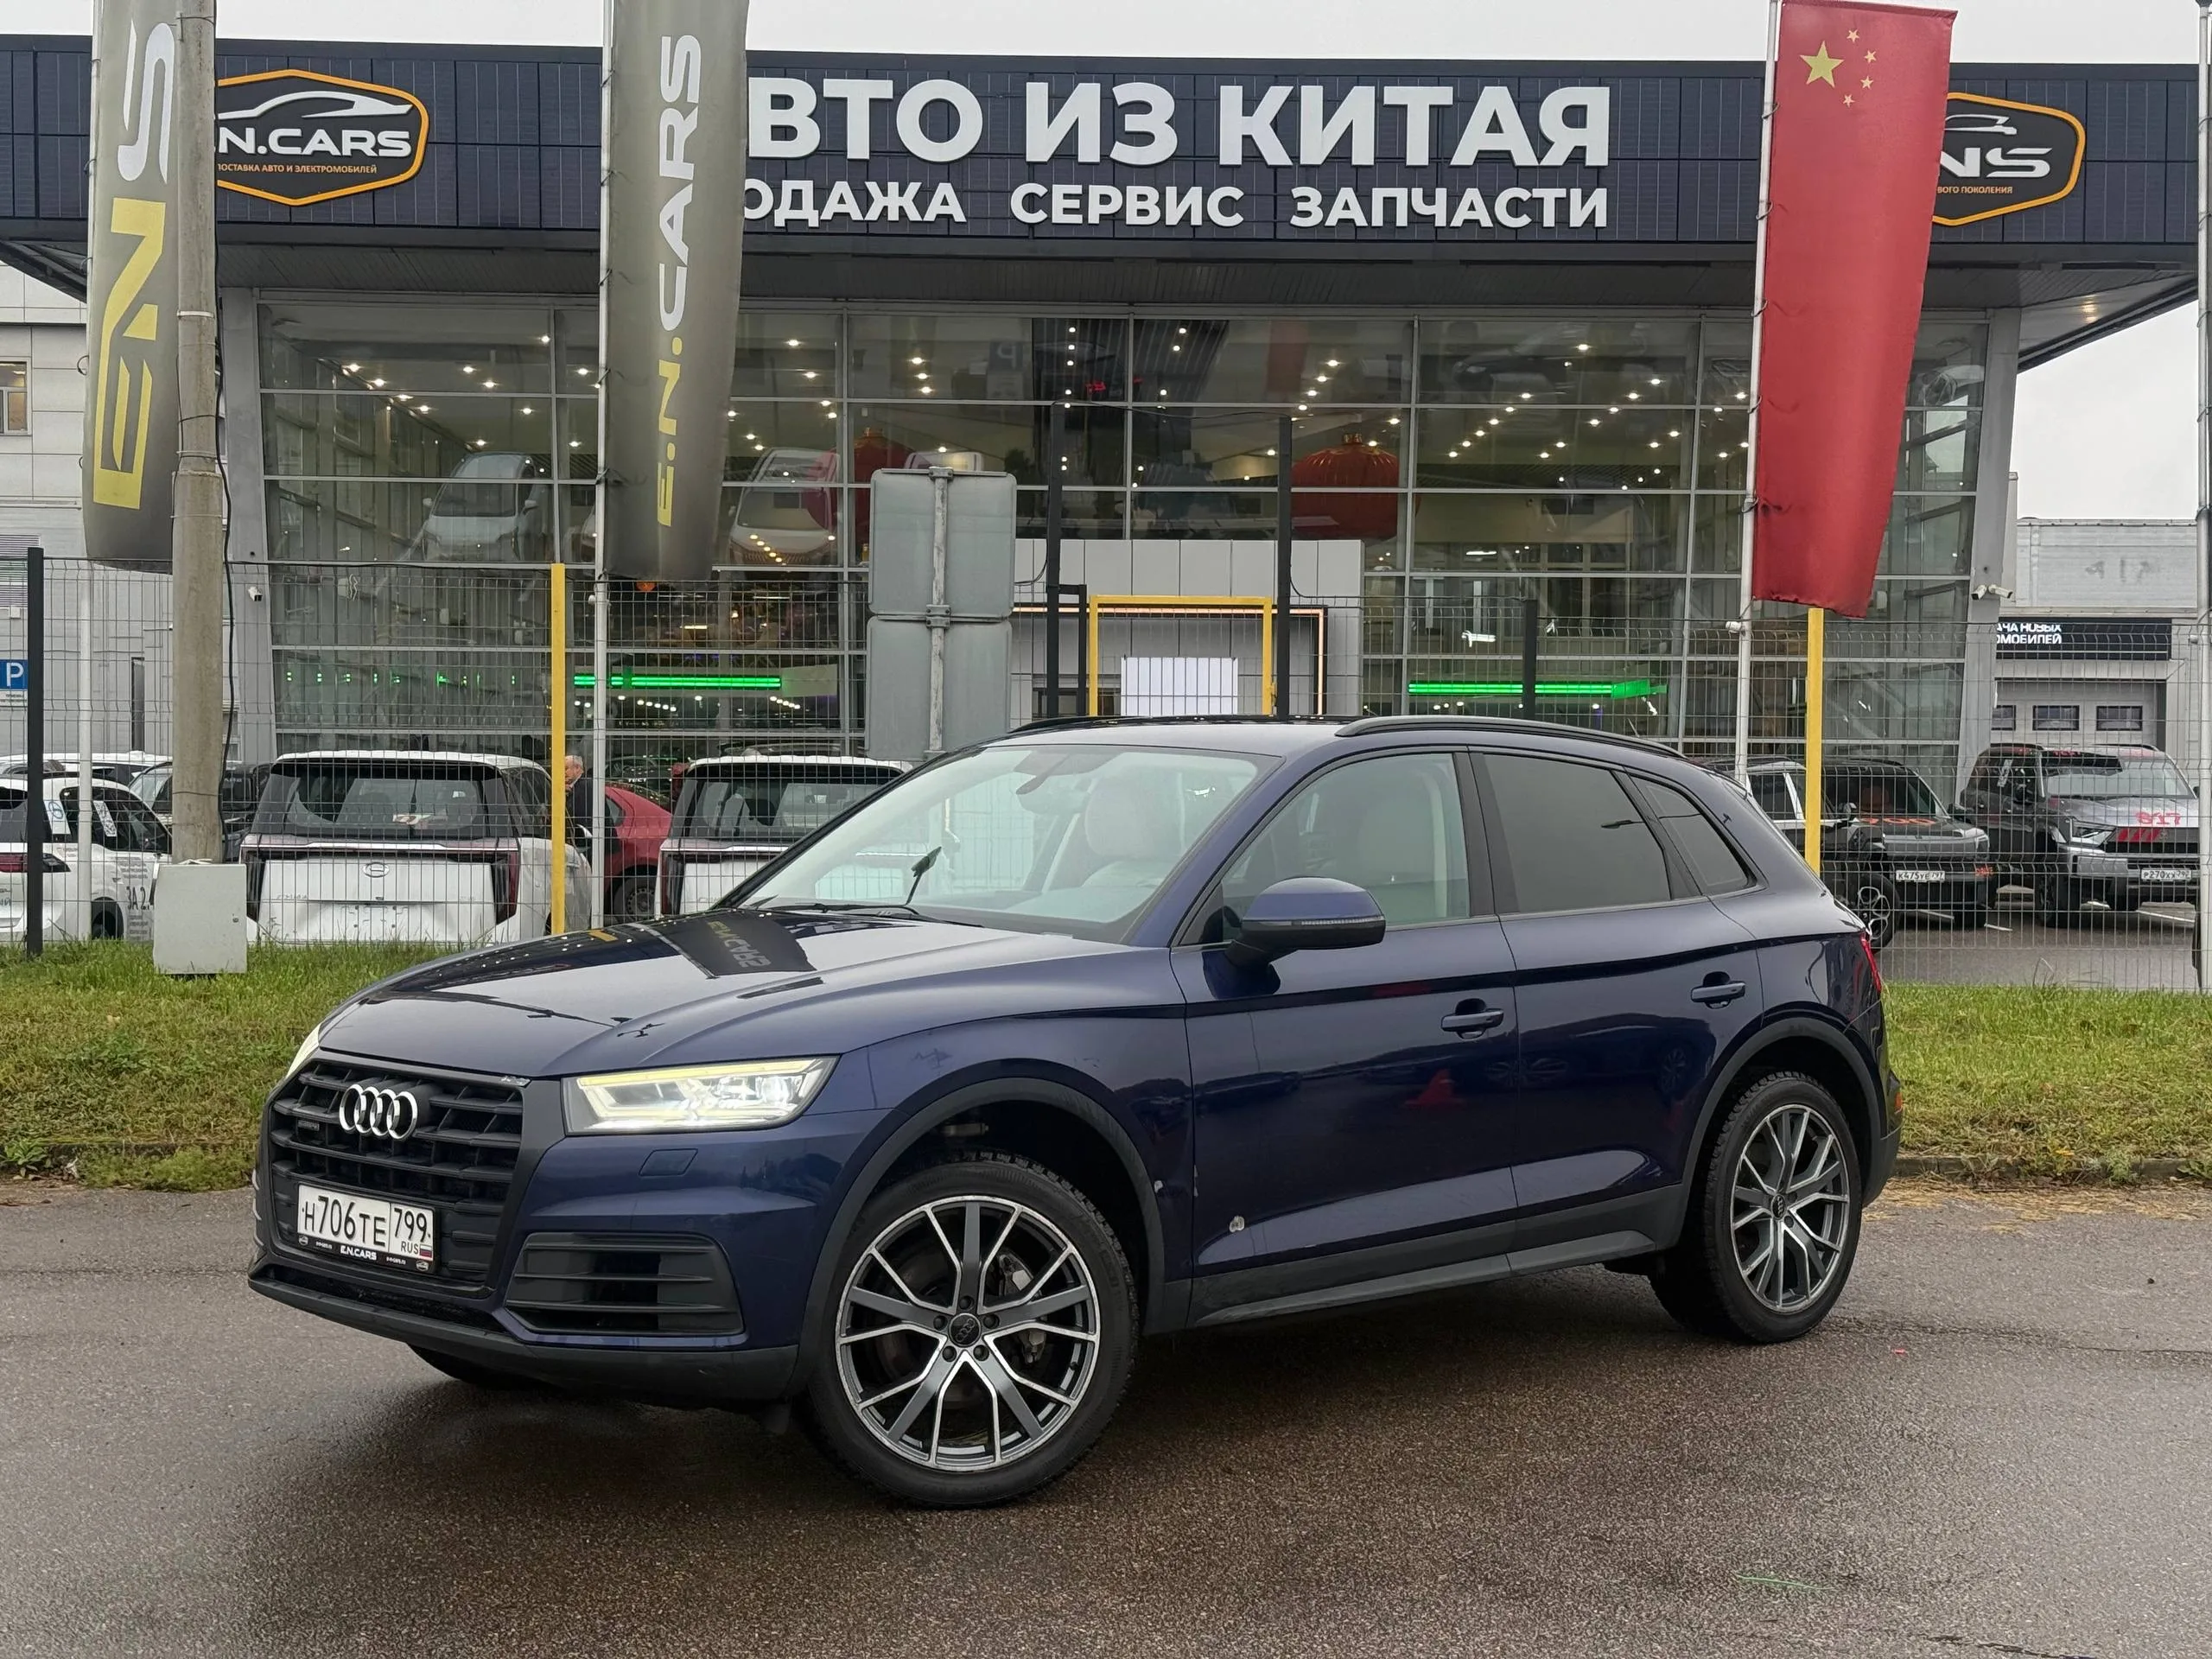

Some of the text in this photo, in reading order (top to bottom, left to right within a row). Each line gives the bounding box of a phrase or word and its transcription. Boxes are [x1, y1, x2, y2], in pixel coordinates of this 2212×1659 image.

[748, 76, 1611, 168] ВТО ИЗ КИТАЯ
[218, 127, 412, 158] N.CARS
[261, 163, 284, 173] АВТО
[286, 164, 294, 173] И
[295, 163, 378, 175] ЭЛЕКТРОМОБИЛЕЙ
[1940, 147, 2053, 178] NS
[743, 177, 1608, 228] ОДАЖА СЕРВИС ЗАПЧАСТИ
[1936, 185, 2013, 194] ВОГО ПОКОЛЕНИЯ
[657, 34, 702, 527] E.N.CARS
[6, 662, 24, 687] P
[394, 1207, 428, 1243] 799
[400, 1241, 419, 1255] RUS
